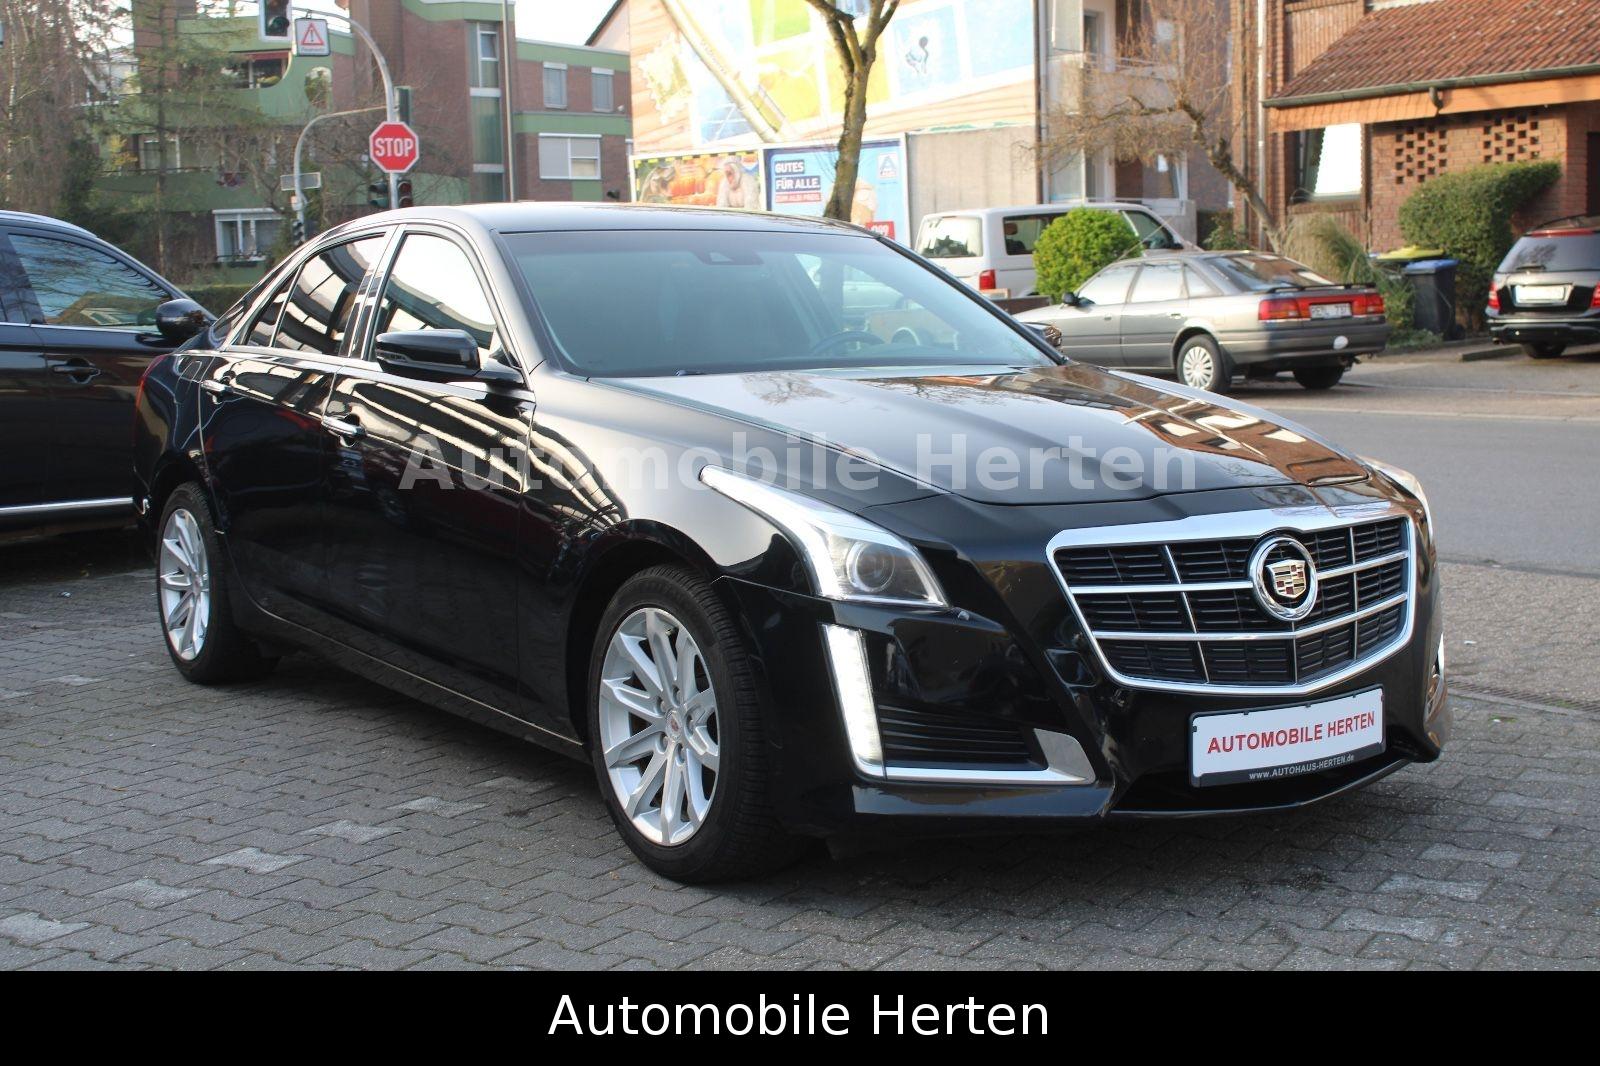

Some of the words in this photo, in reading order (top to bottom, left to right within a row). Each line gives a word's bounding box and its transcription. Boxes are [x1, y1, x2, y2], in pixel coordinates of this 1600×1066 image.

[375, 138, 414, 157] STOP
[775, 162, 804, 173] GUTES
[776, 177, 794, 190] FÜR
[1207, 724, 1323, 754] AUTOMOBILE
[1327, 711, 1375, 738] HERTEN
[1249, 754, 1354, 780] www.AUTOHAUS-HERTEN.de
